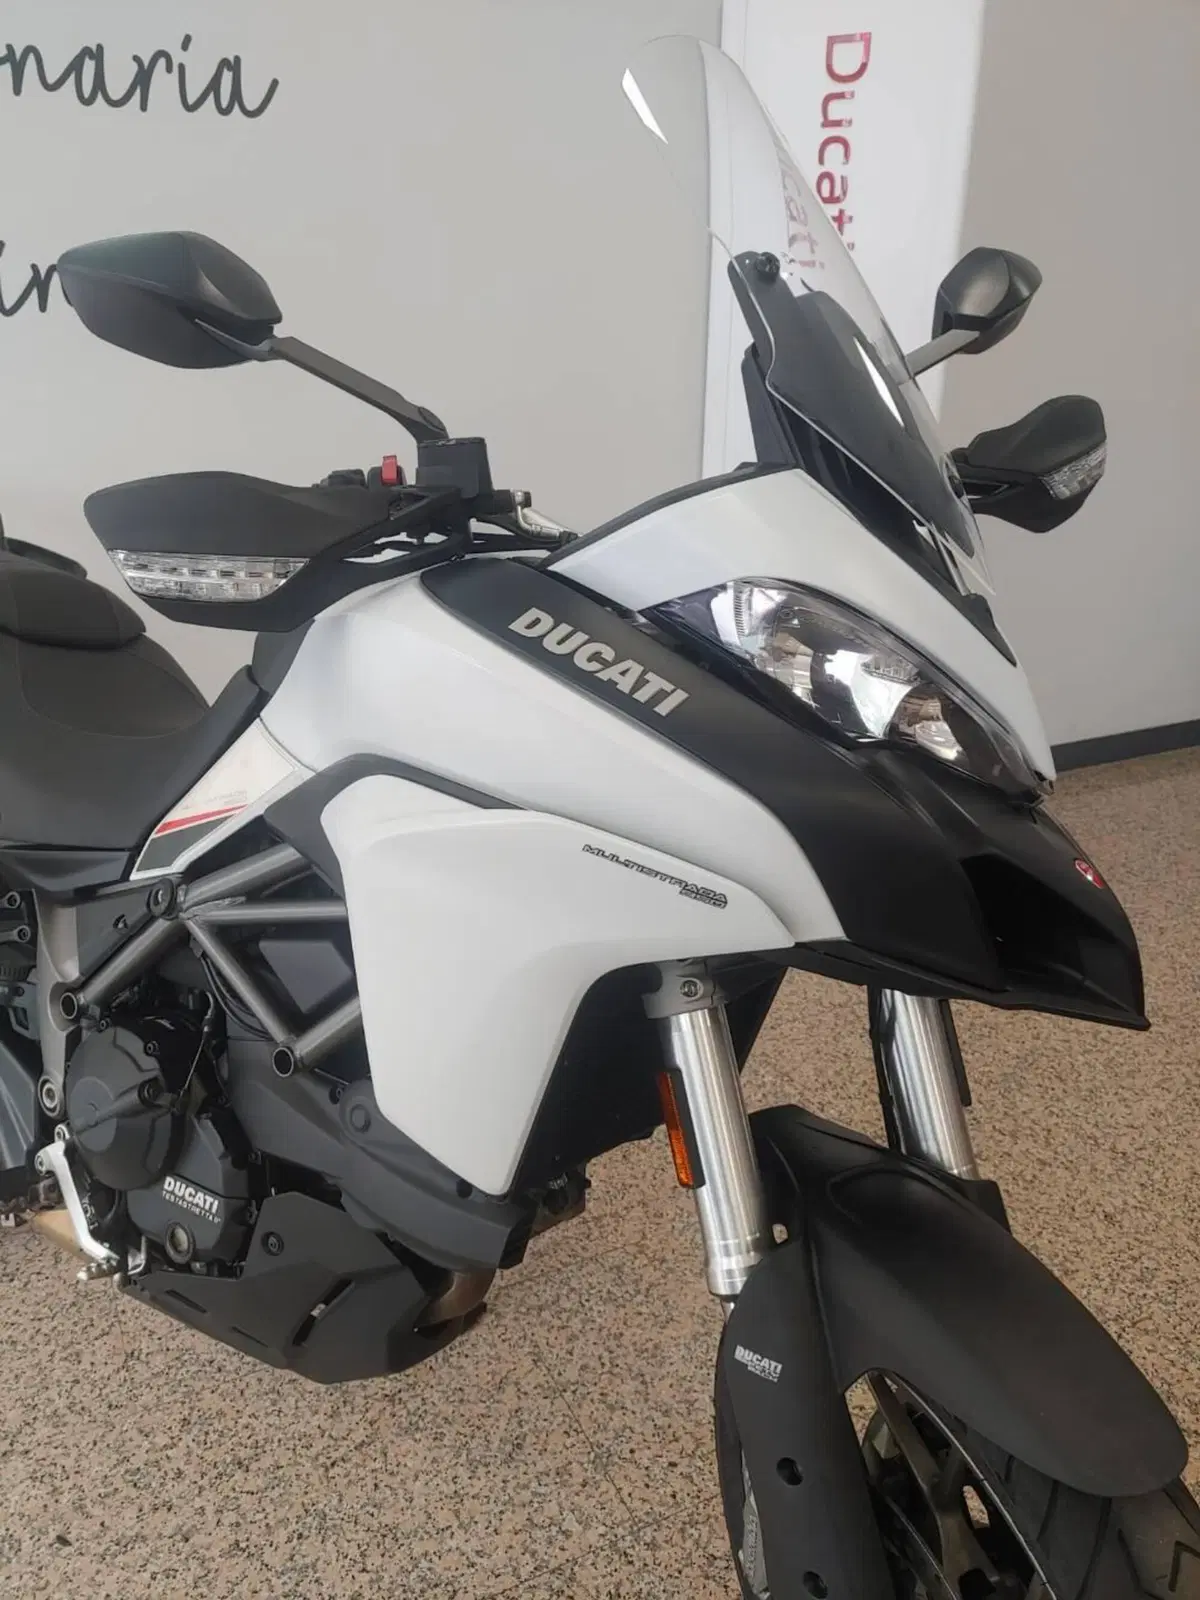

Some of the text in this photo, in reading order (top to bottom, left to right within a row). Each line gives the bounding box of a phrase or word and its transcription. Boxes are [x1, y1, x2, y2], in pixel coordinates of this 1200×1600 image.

[815, 31, 872, 252] Ducat
[507, 607, 690, 717] DUCATI
[582, 844, 728, 904] MULTISTRADA
[163, 1176, 219, 1214] DUCATI
[733, 1345, 782, 1374] DUCATI
